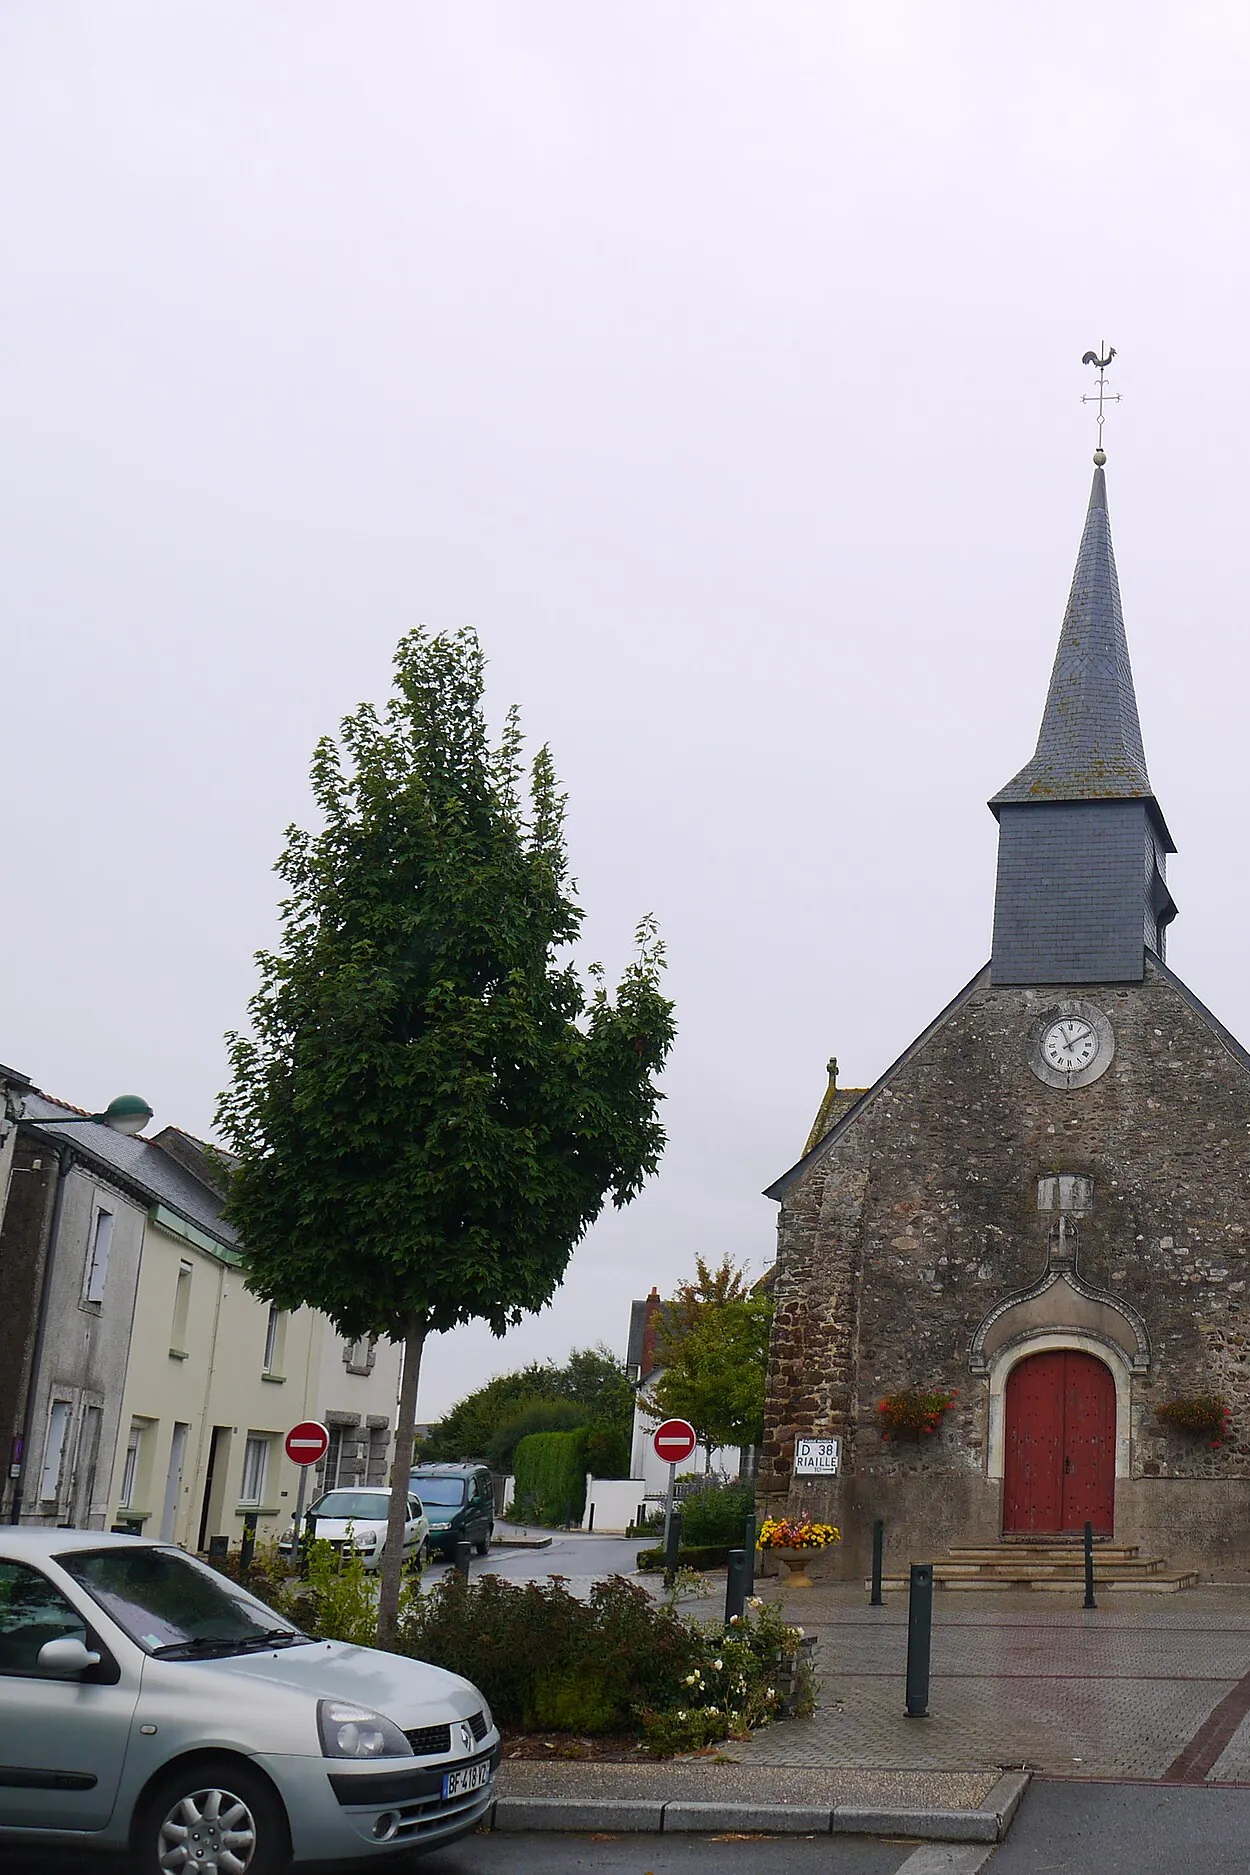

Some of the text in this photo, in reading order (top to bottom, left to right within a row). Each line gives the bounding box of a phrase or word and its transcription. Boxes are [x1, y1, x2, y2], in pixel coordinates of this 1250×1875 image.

[801, 1444, 833, 1456] D 38
[797, 1456, 837, 1467] RIAILLE
